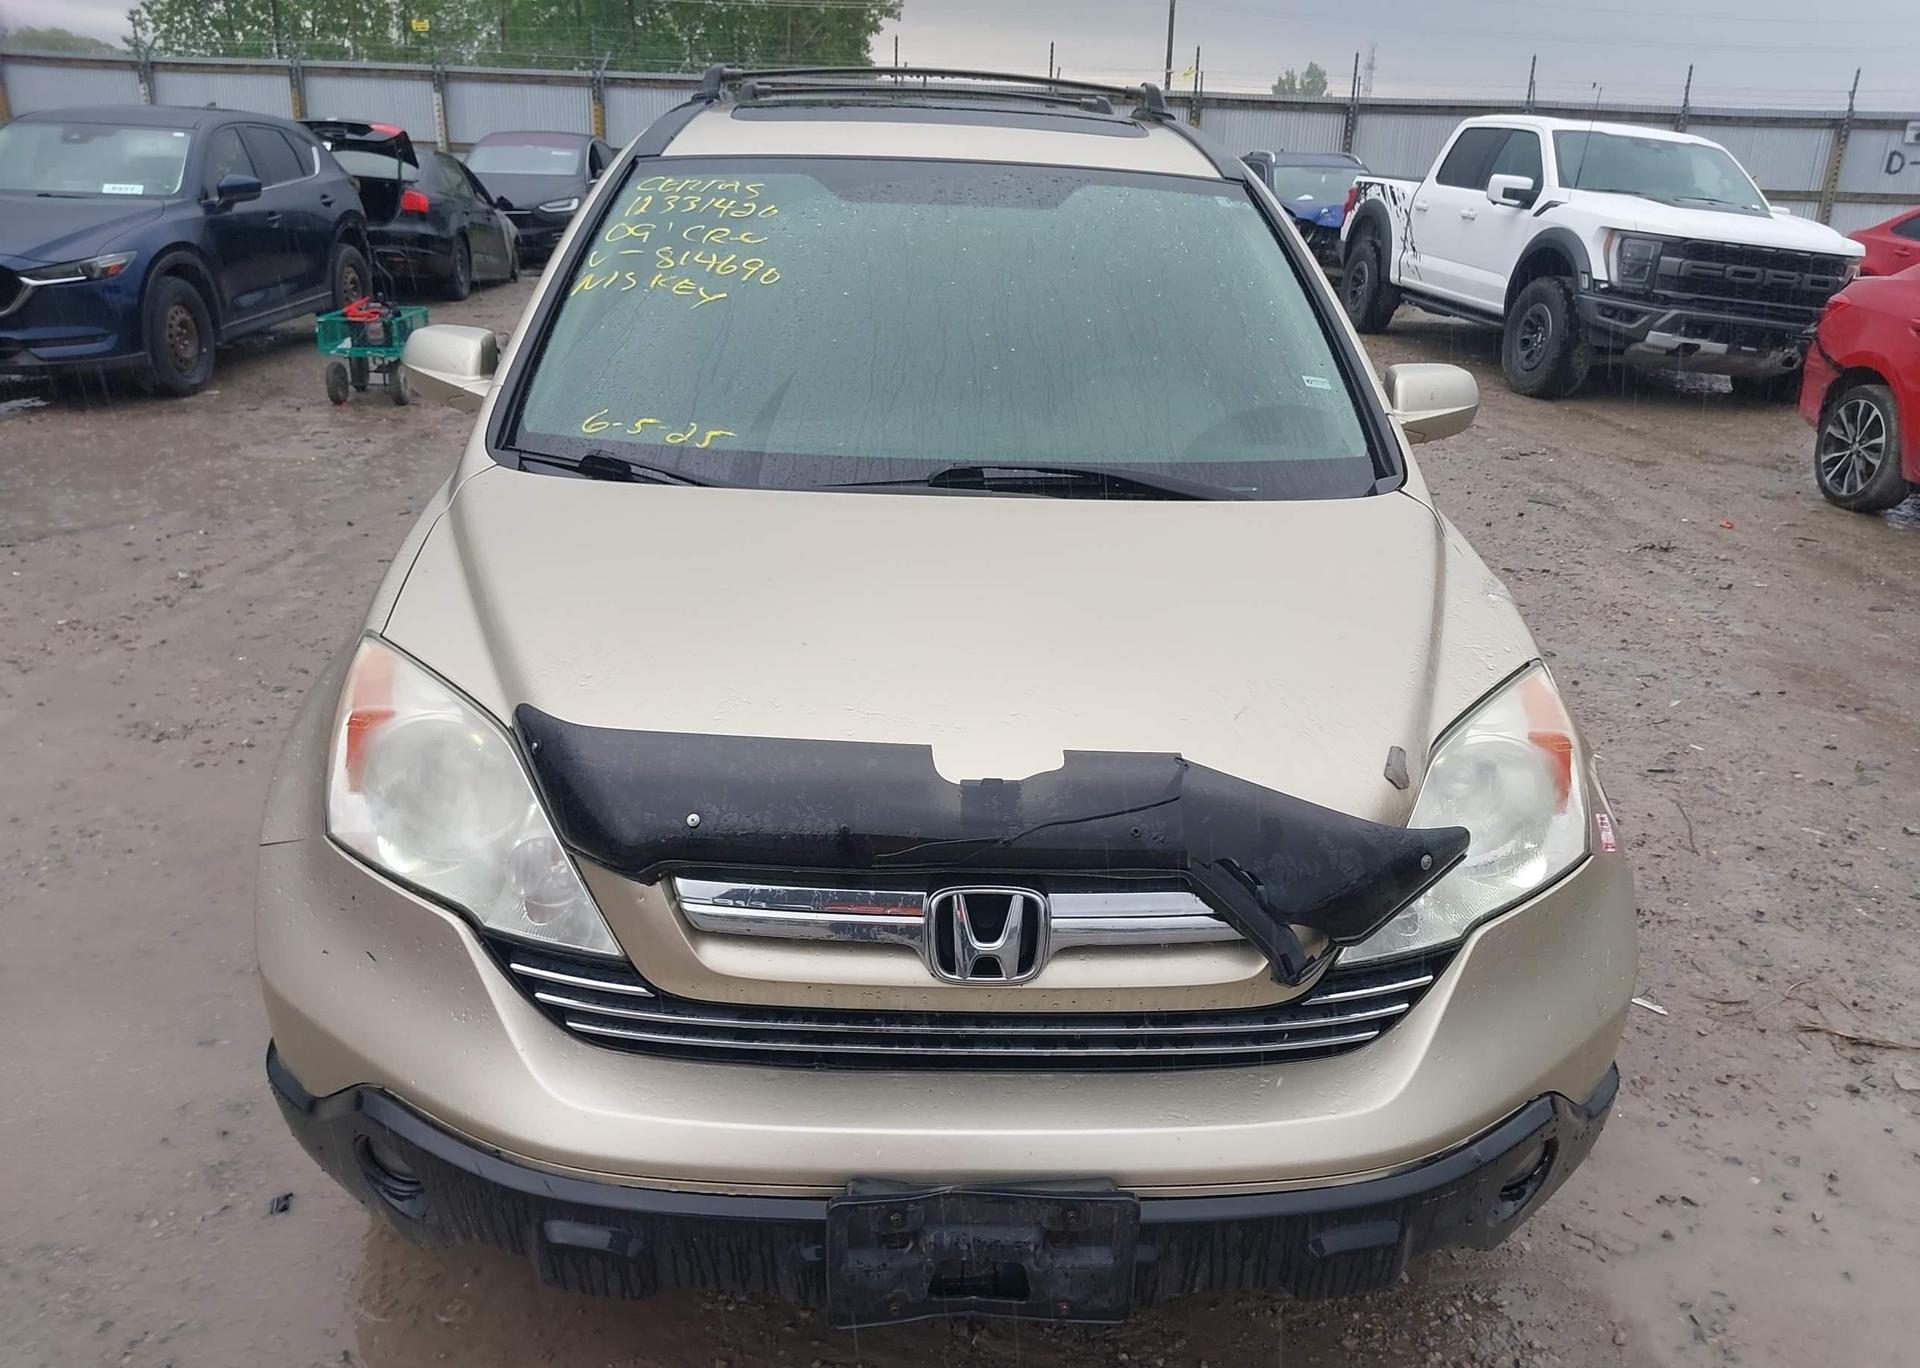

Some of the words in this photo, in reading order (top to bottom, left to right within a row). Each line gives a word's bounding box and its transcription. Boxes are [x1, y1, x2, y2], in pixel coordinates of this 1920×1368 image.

[650, 272, 728, 310] KEY
[1678, 258, 1843, 294] FORD
[581, 408, 739, 449] 6-5-25
